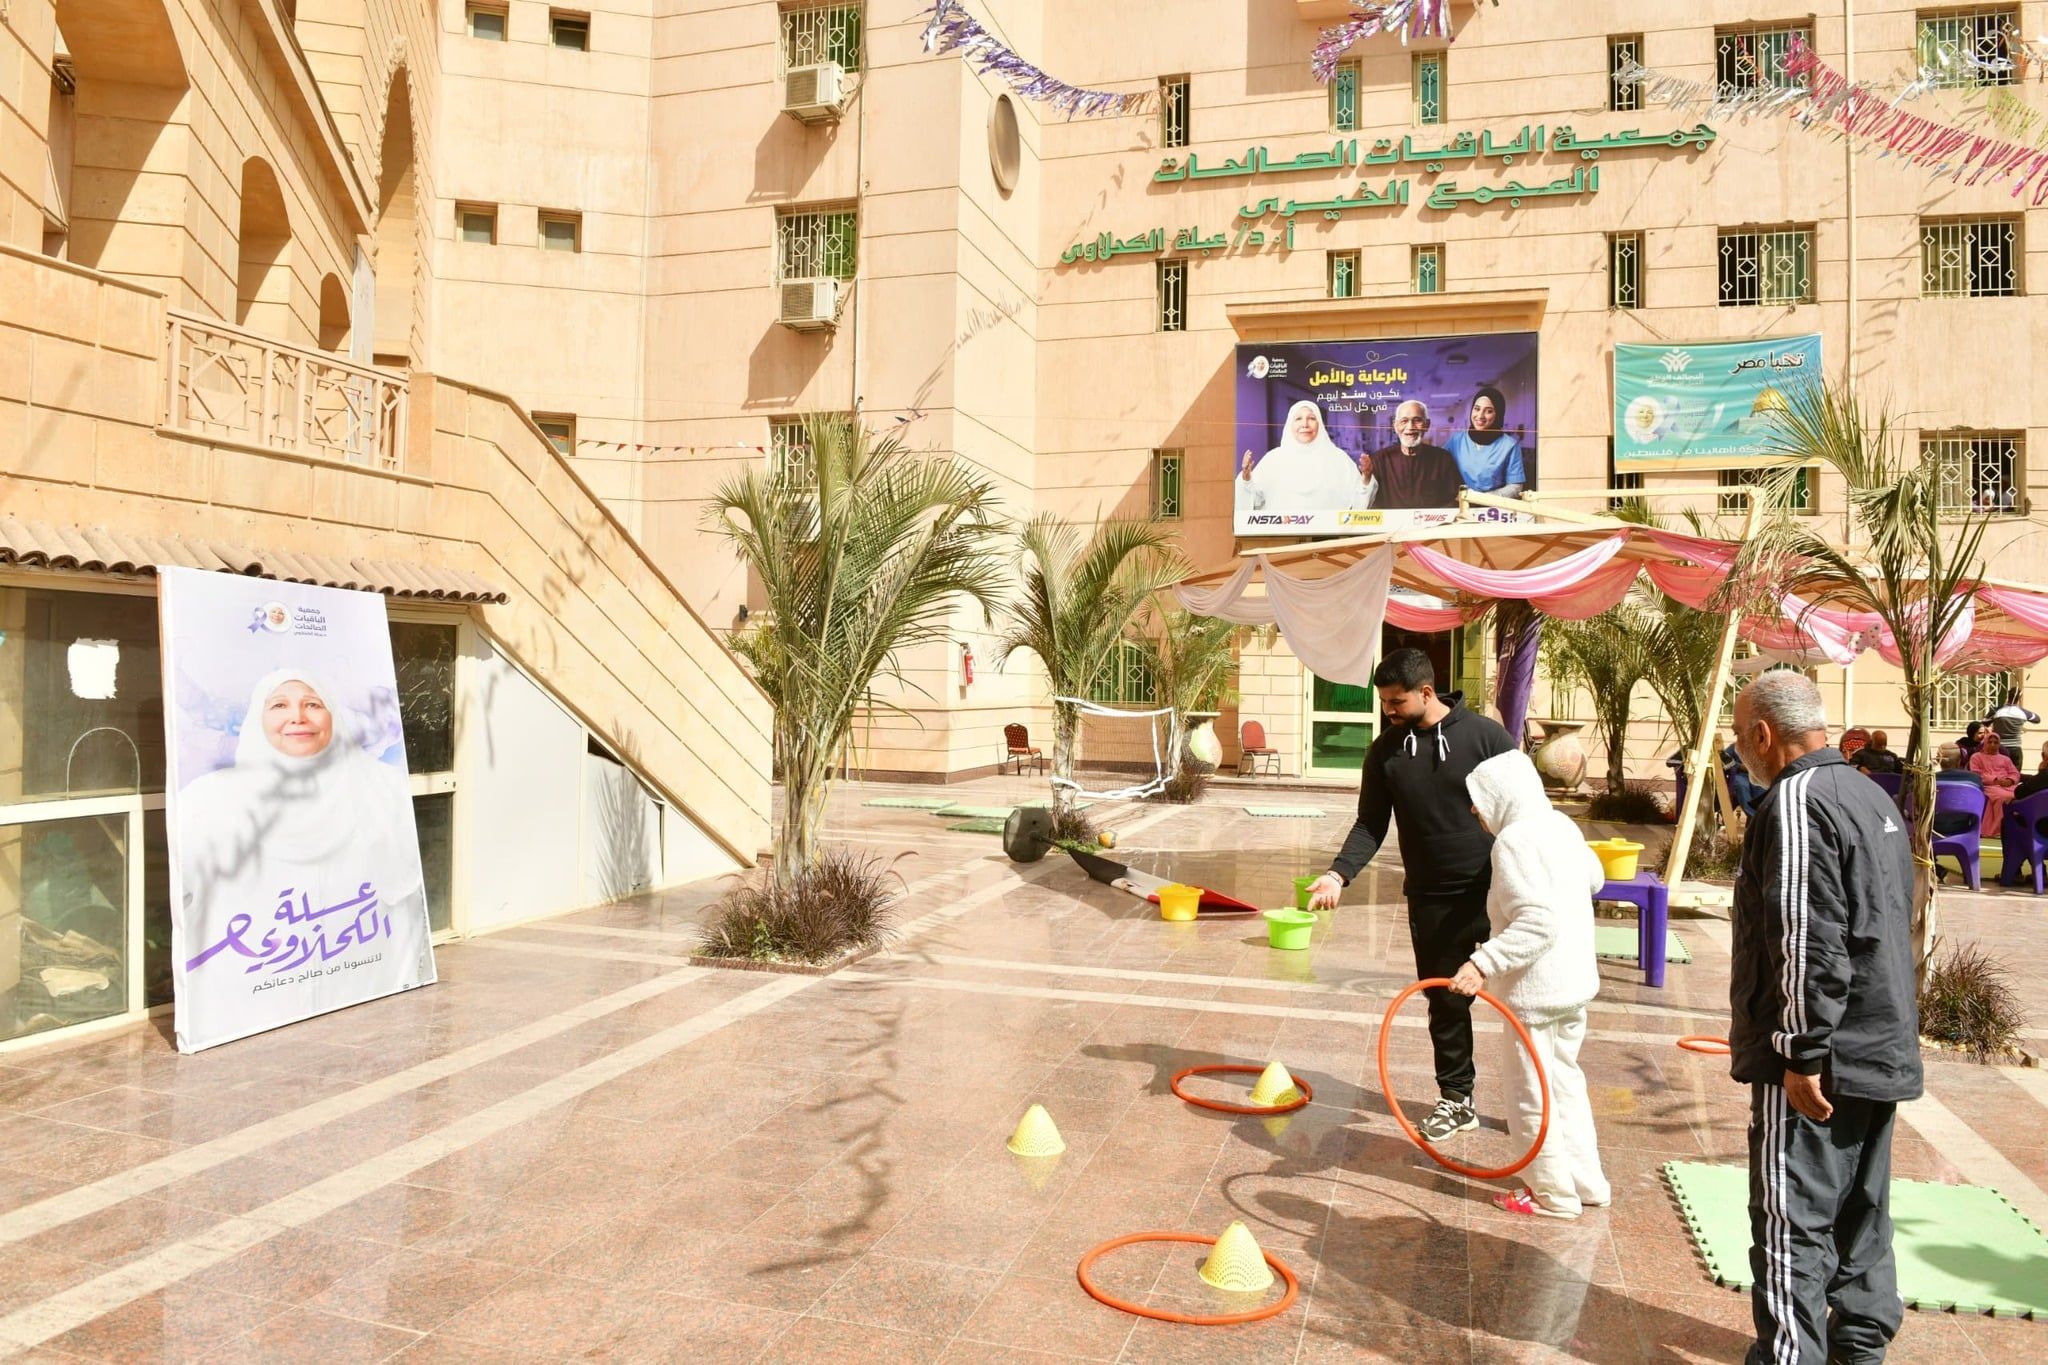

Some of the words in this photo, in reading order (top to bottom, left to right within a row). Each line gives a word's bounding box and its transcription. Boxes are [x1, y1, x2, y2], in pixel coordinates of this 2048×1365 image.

[1365, 125, 1544, 172] الباقيات
[1553, 123, 1717, 160] جمعية
[1154, 138, 1357, 182] الصالحات
[1426, 165, 1599, 209] المجمع
[1175, 226, 1228, 257] عبلة
[1729, 357, 1767, 375] مصر
[1769, 350, 1805, 373] تحيا
[1309, 367, 1355, 387] والأمل
[1358, 367, 1408, 385] بالرعاية
[1316, 389, 1339, 402] ليهم
[1340, 390, 1367, 399] سند
[1328, 401, 1352, 413] لحظة
[1354, 401, 1369, 413] كل
[1371, 401, 1388, 414] في
[1353, 514, 1381, 523] fawry
[294, 614, 326, 625] الباقيات
[294, 623, 327, 632] الصالحات
[274, 882, 377, 933] عبلة
[298, 969, 323, 983] صالح
[326, 965, 341, 975] من
